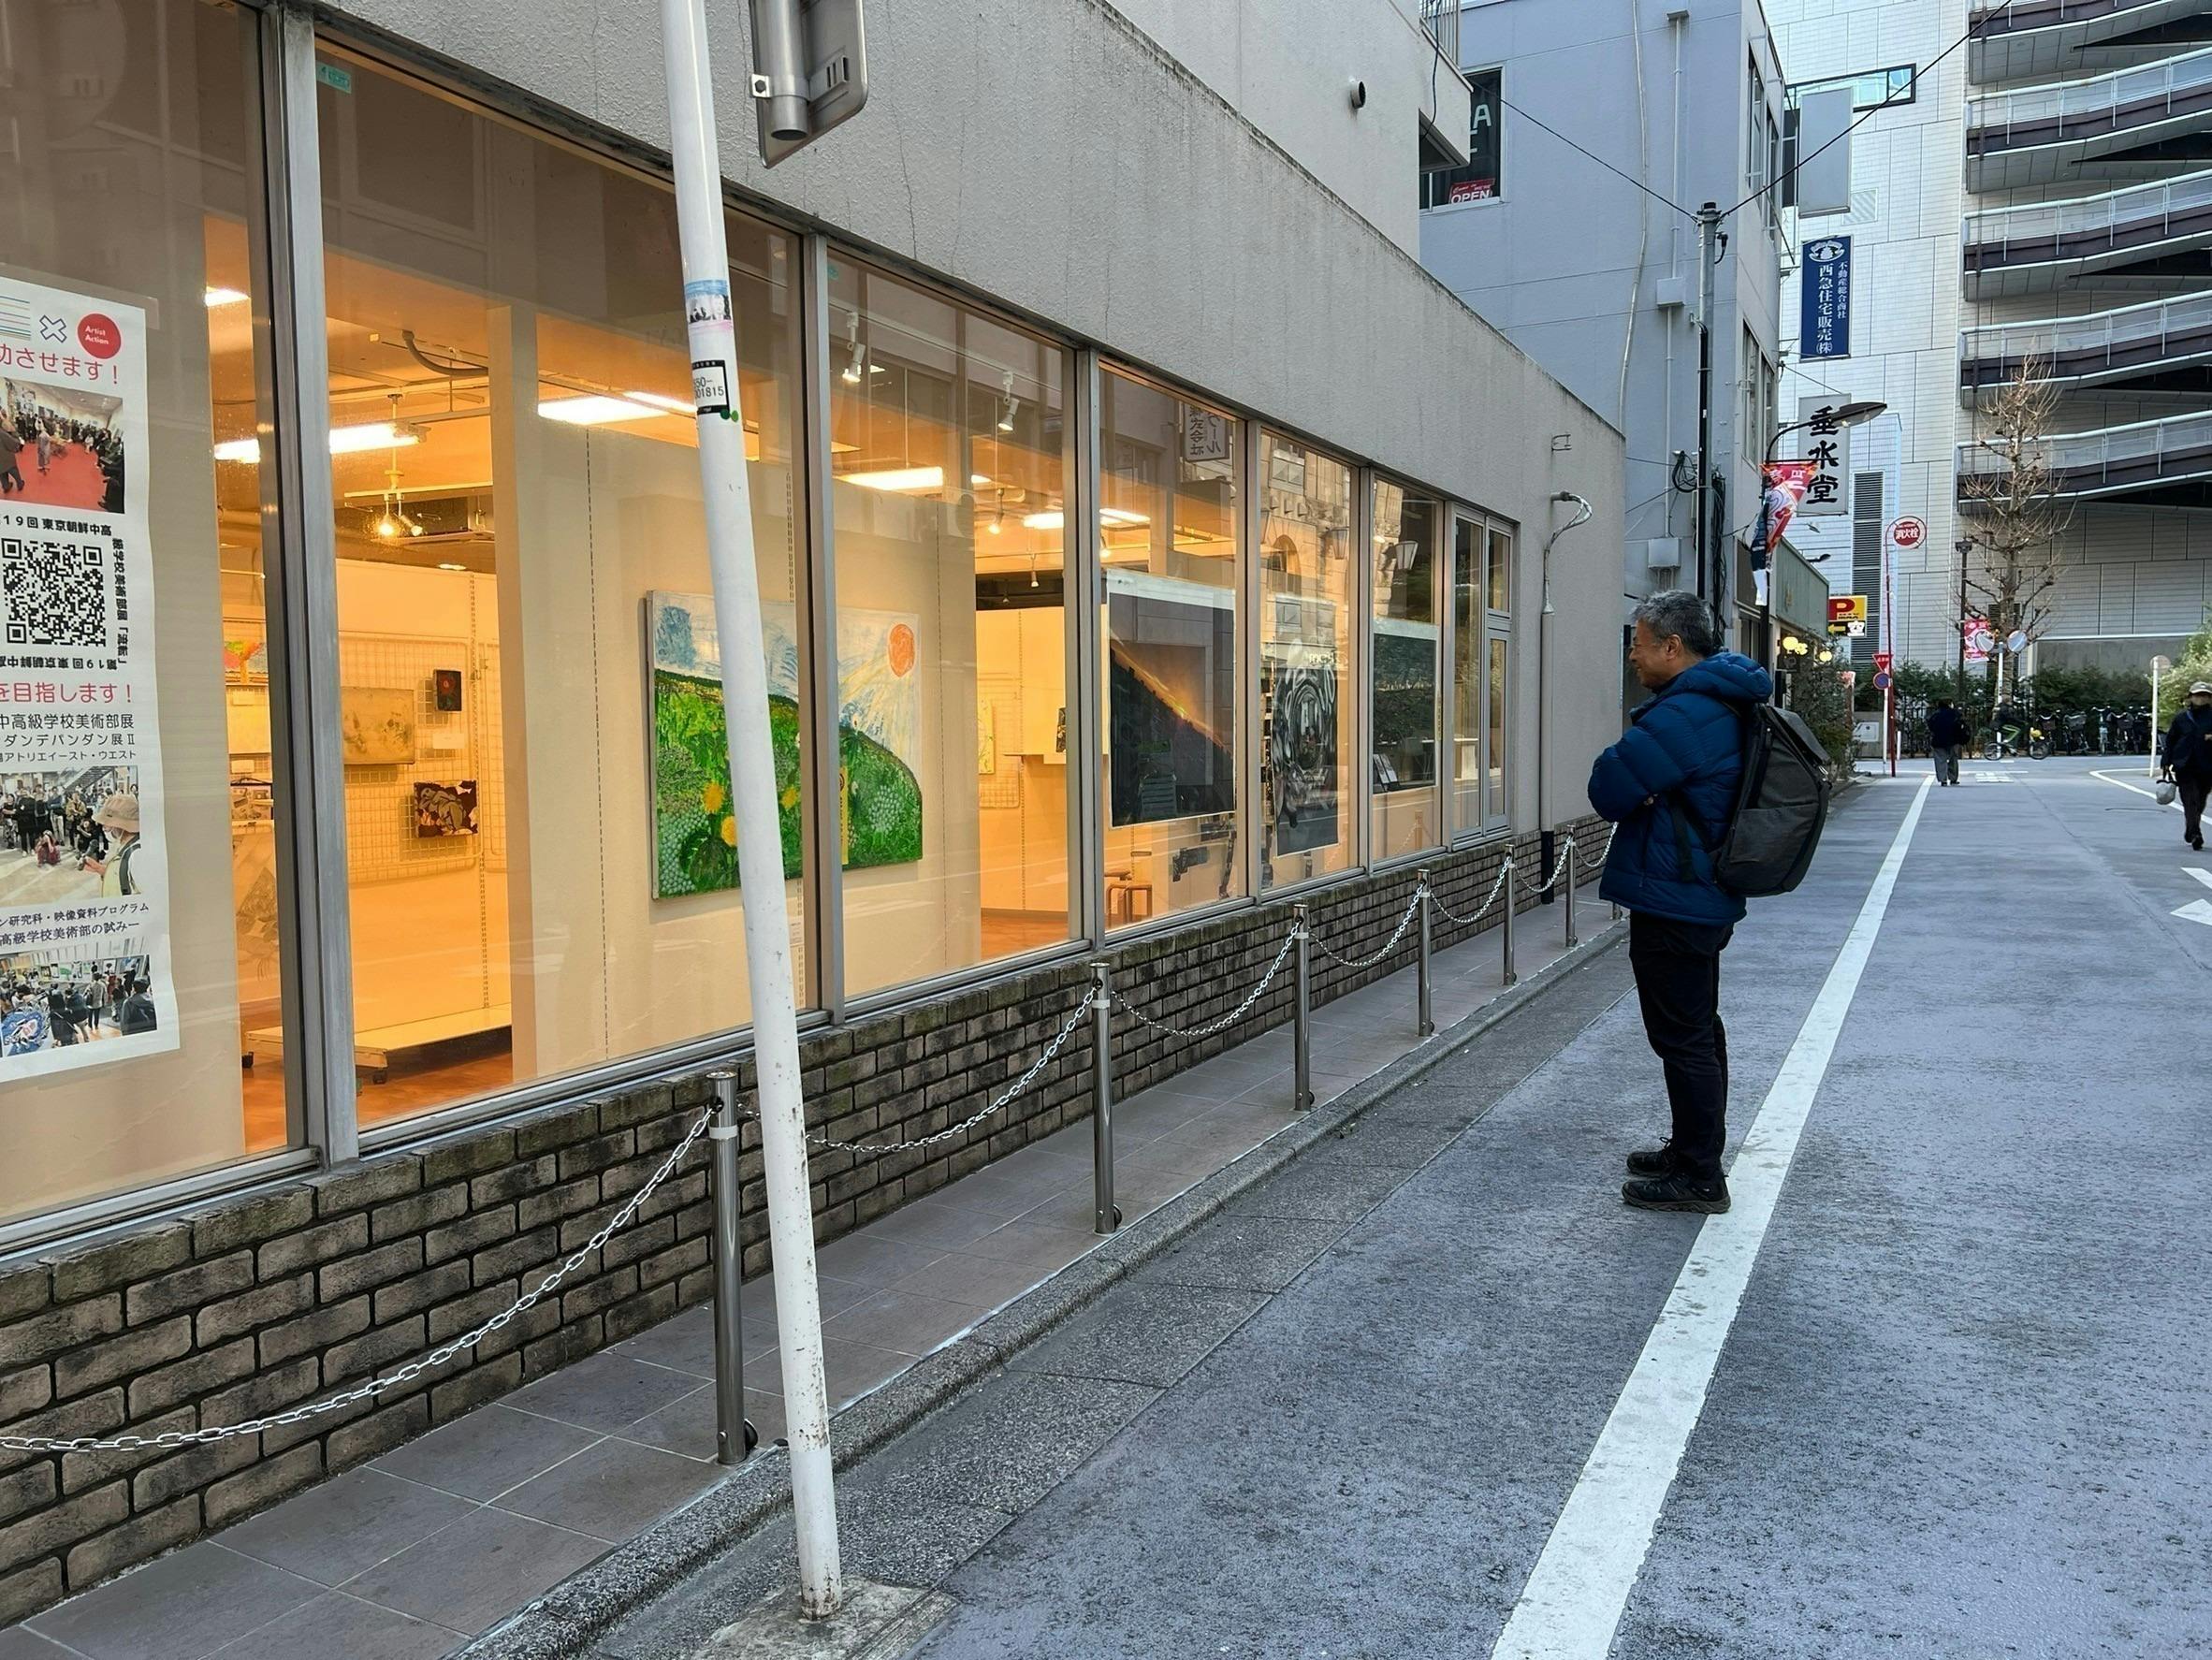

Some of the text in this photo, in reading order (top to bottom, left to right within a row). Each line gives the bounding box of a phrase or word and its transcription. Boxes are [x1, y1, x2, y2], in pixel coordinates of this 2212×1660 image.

[1451, 189, 1491, 203] OPEN
[85, 326, 106, 336] Artist
[85, 334, 109, 344] Action
[695, 386, 724, 400] 01815
[1806, 405, 1840, 504] 垂水堂
[1895, 527, 1919, 540] 消火栓
[1828, 599, 1855, 620] P
[1847, 619, 1865, 636] 空
[0, 713, 134, 730] 中高級学校美術部展
[0, 750, 137, 763] アトリエイースト・ウエスト
